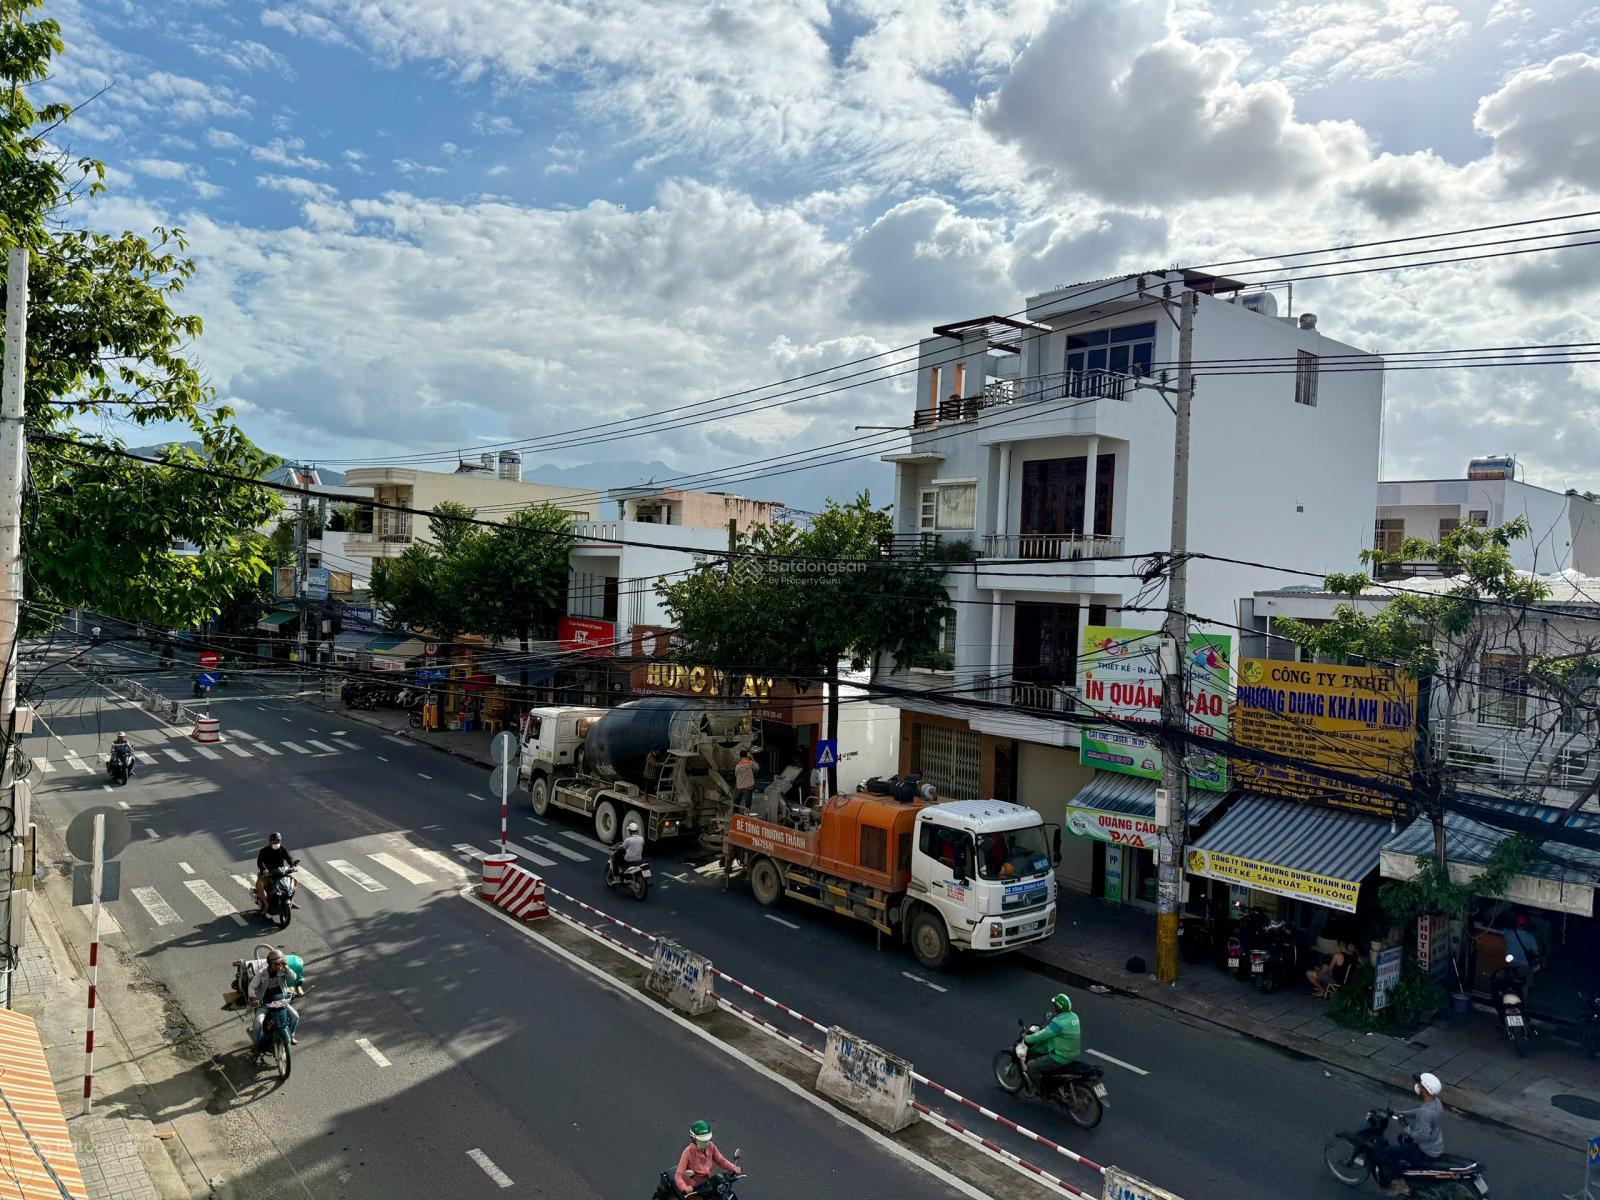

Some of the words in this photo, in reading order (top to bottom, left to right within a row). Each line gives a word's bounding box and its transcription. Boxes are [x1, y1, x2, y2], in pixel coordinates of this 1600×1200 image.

[1272, 666, 1311, 684] CÔNG
[1317, 673, 1337, 687] TY
[1342, 675, 1389, 692] TNHH
[1289, 691, 1325, 717] DUNG
[1329, 692, 1378, 723] KHÁNH
[1135, 819, 1157, 834] CÁO
[1211, 853, 1230, 864] CÔNG
[1231, 857, 1239, 866] TY
[1240, 860, 1258, 870] TNHH
[1290, 871, 1311, 882] DUNG
[1308, 885, 1324, 894] THI
[1325, 889, 1354, 901] CÔNG
